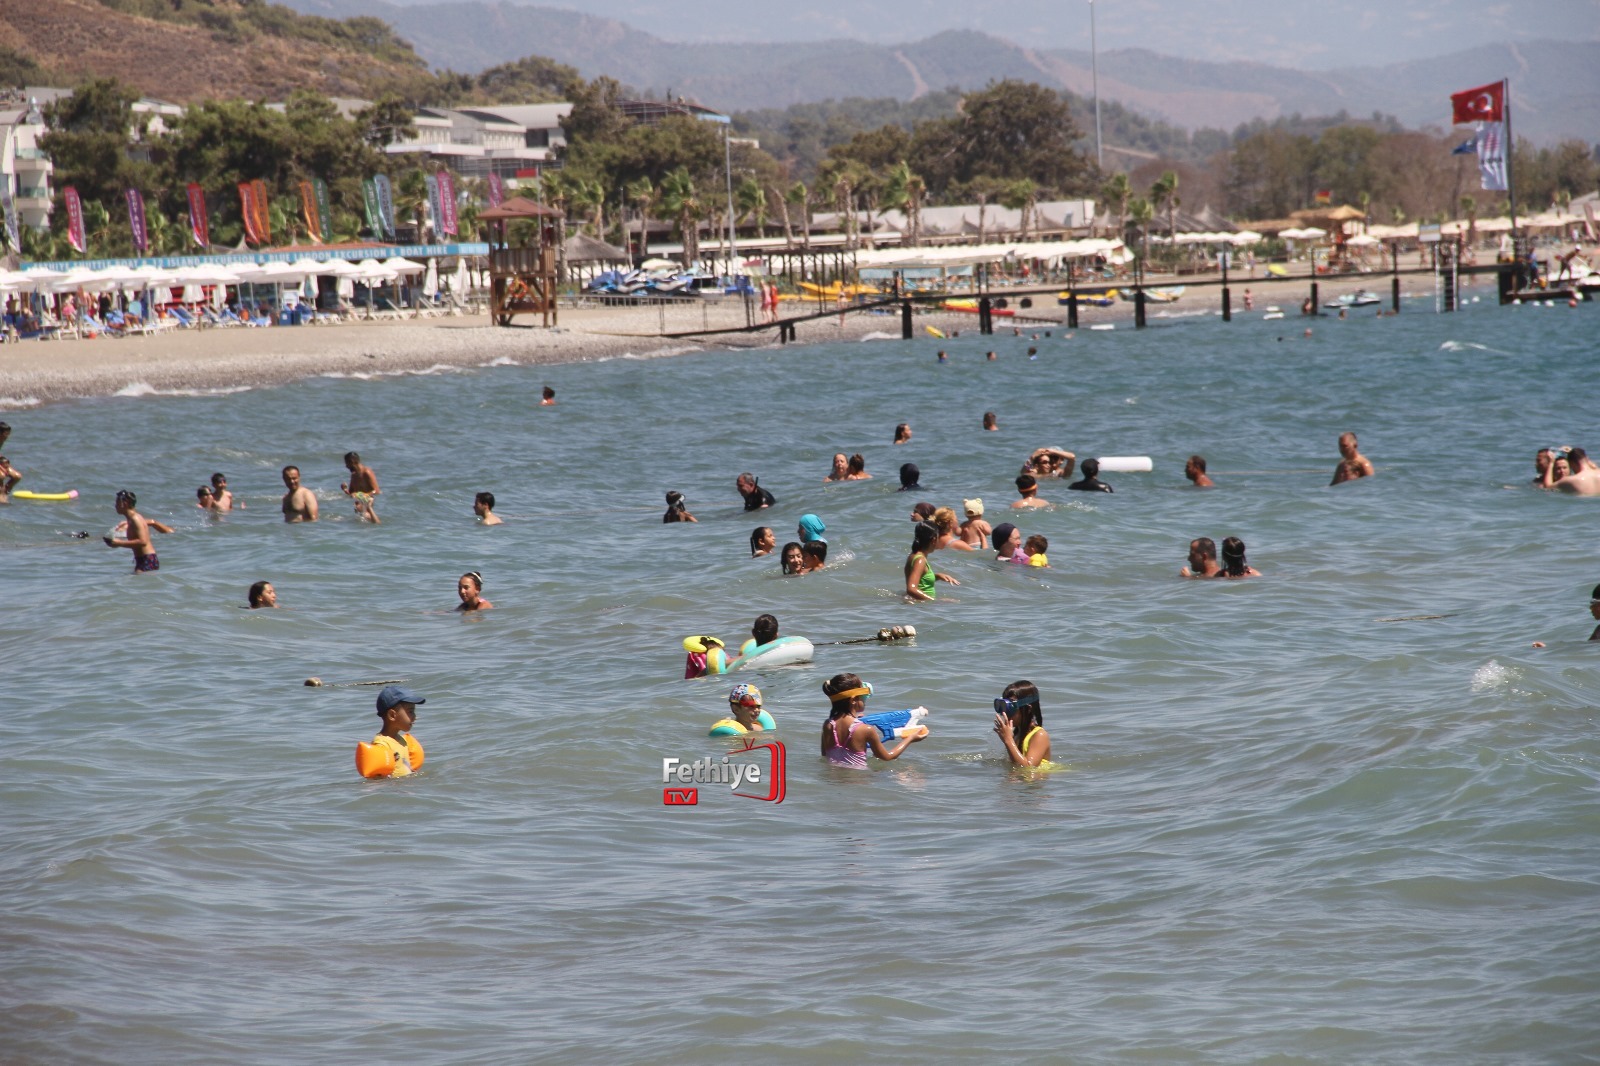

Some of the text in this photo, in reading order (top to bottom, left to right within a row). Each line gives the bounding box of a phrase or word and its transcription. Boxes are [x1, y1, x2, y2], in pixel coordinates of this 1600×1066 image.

[168, 256, 201, 267] ISLAND
[204, 254, 254, 264] EXCURSION
[269, 252, 290, 262] BLUE
[294, 251, 331, 261] LAGOON
[335, 248, 387, 259] EXCURSION
[390, 248, 397, 257] &
[400, 246, 424, 256] BOAT
[427, 245, 448, 255] HIRE
